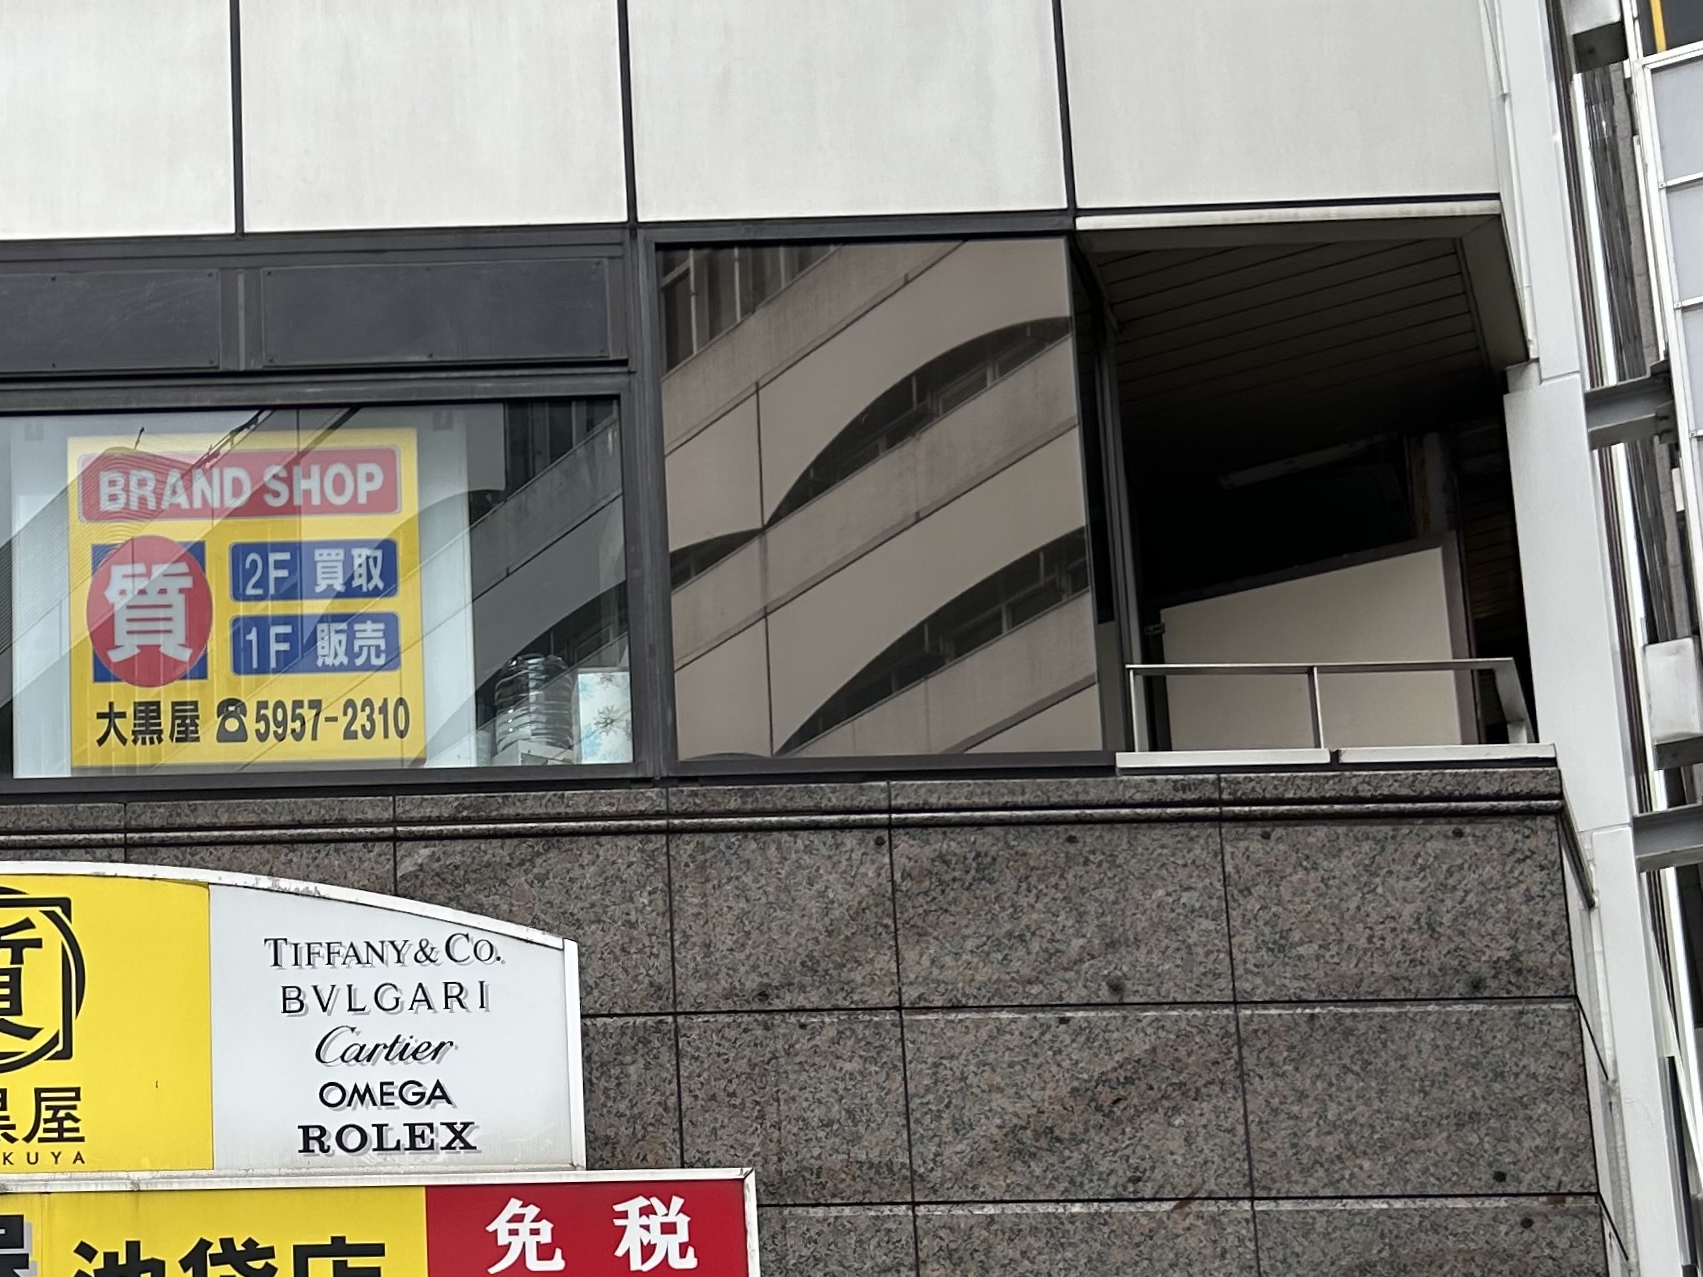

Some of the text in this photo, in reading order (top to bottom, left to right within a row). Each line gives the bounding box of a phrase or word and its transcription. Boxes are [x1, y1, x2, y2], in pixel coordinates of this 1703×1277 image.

[99, 462, 385, 512] BRAND SHOP
[245, 545, 385, 596] 2F 買取
[105, 560, 196, 663] 質
[245, 619, 387, 671] 1F 販売
[94, 696, 411, 748] 大黒屋 5957-2310
[281, 980, 488, 1015] BVLGARI
[315, 1025, 455, 1067] Cartier
[318, 1079, 454, 1108] OMEGA
[297, 1121, 477, 1154] ROLEX
[485, 1194, 698, 1274] 免税
